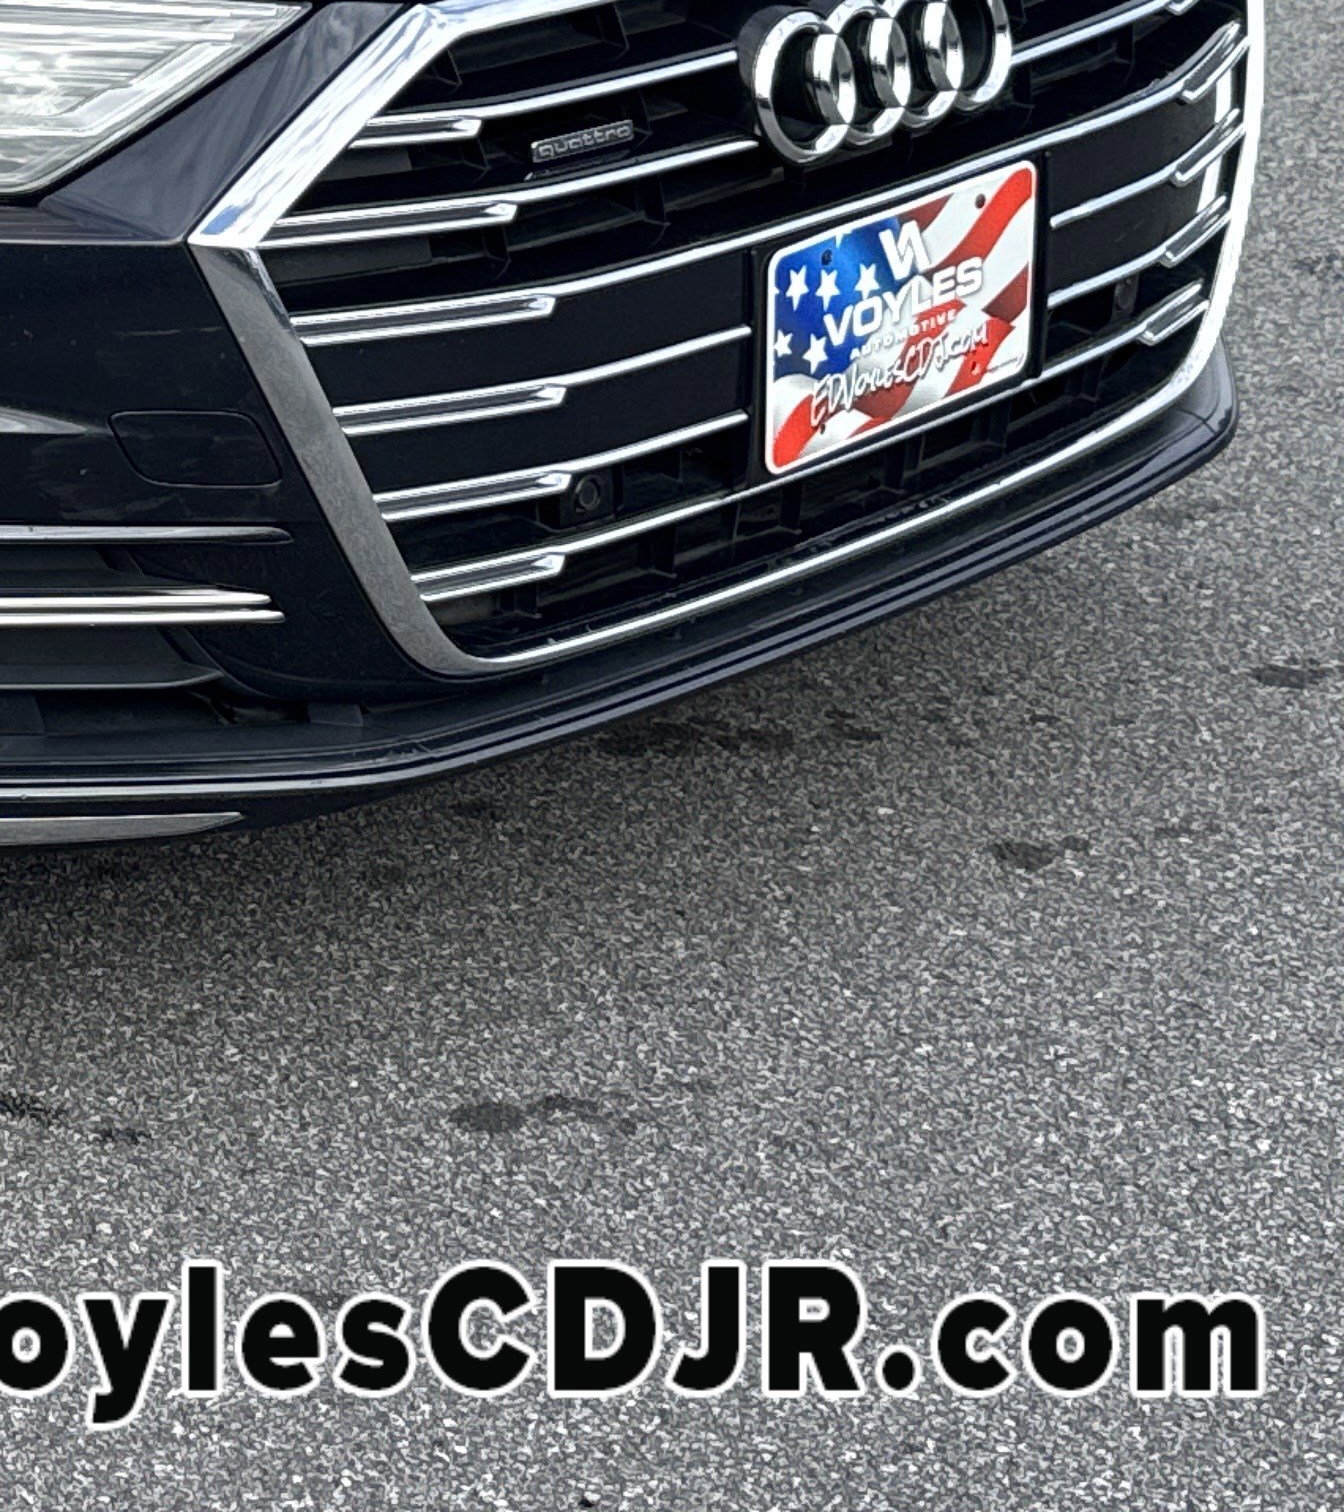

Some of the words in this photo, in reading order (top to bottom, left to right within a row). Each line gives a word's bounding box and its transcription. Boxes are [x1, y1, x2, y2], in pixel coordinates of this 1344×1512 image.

[537, 124, 631, 158] quattro
[823, 256, 983, 347] VOYLES
[849, 308, 957, 361] AUTOMOTIVE
